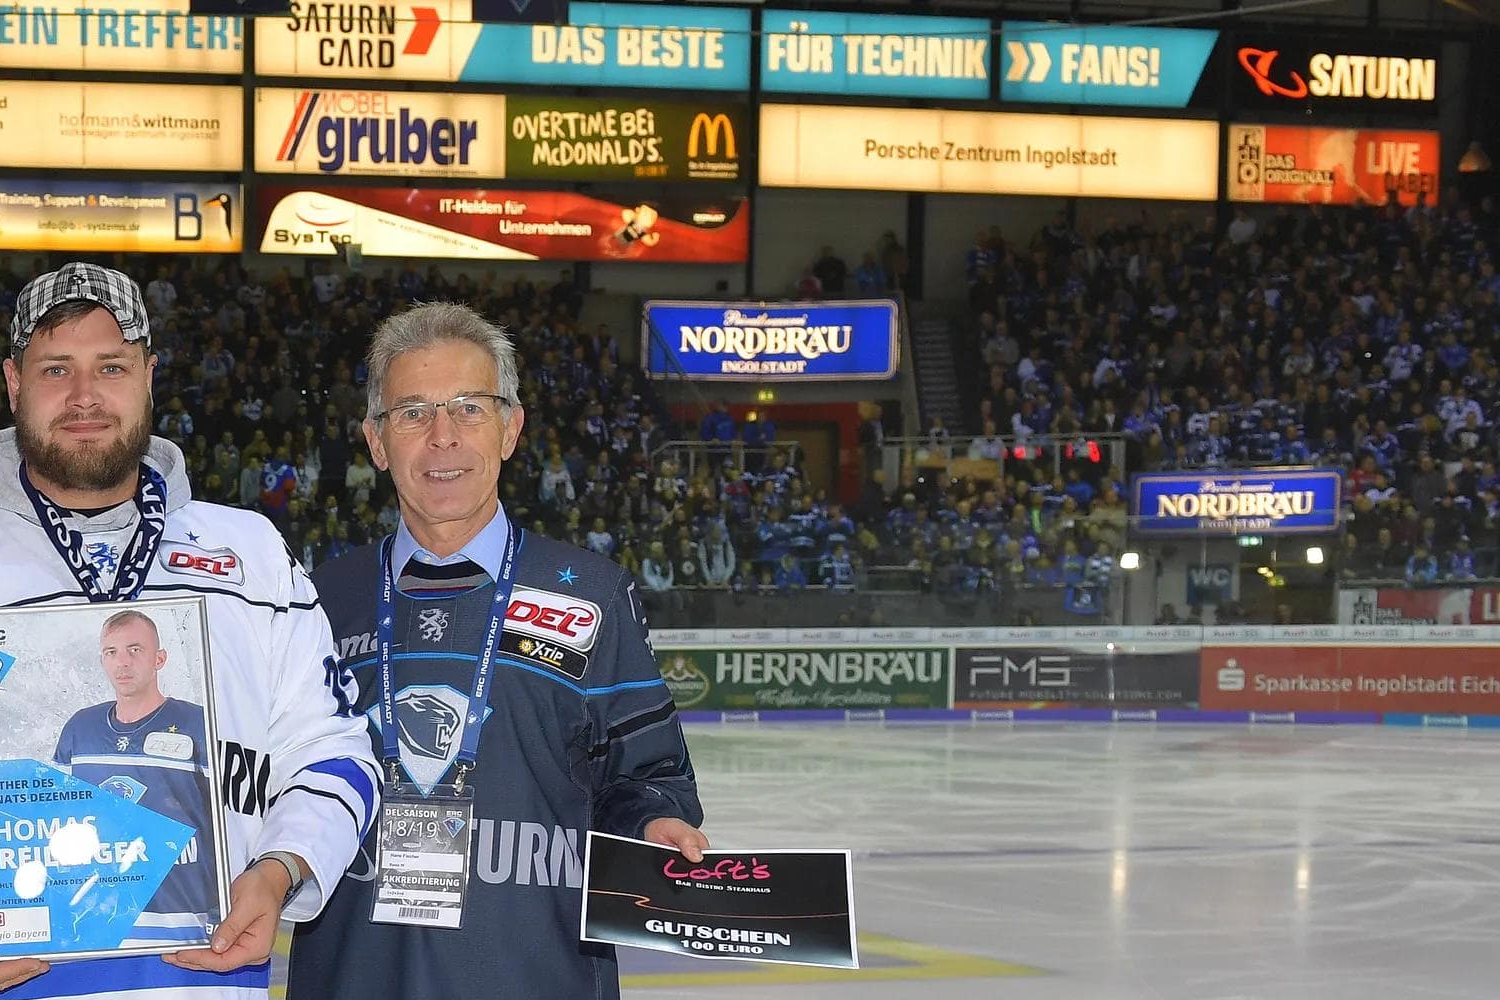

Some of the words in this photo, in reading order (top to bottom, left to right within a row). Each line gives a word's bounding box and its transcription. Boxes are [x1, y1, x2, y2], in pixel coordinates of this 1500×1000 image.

[78, 8, 243, 50] TREFFER!
[287, 2, 396, 35] SATURN
[318, 38, 395, 69] CARD
[531, 24, 604, 65] DAS
[616, 25, 725, 69] BESTE
[768, 22, 832, 73] FÜR
[845, 34, 987, 79] TECHNIK
[1060, 44, 1161, 88] FANS!
[1309, 53, 1436, 100] SATURN
[317, 107, 478, 172] gruber
[863, 139, 941, 162] Porsche
[943, 142, 1022, 164] Zentrum
[1026, 143, 1118, 171] Ingolstadt
[1367, 141, 1421, 176] LIVE
[504, 200, 527, 215] für
[499, 219, 593, 237] Unternehmen
[679, 325, 853, 360] NORDBRÄU
[1156, 490, 1315, 520] NORDBRÄU
[1190, 566, 1231, 588] WC
[504, 599, 595, 638] DEL
[477, 615, 501, 678] INGOLSTADT
[715, 651, 942, 687] HERRNBRÄU
[970, 655, 1071, 687] FMS
[382, 667, 394, 726] INGOLSTADT
[1254, 673, 1353, 696] Sparkasse
[1358, 673, 1456, 697] Ingolstadt
[29, 790, 94, 803] DEZEMBER
[32, 778, 54, 789] DES
[385, 808, 438, 818] DEL-SAISON
[386, 820, 437, 838] 18/19
[382, 874, 461, 887] AKKREDITIERUNG
[13, 929, 48, 941] Bayern
[644, 919, 791, 947] GUTSCHEIN
[680, 939, 714, 952] 100
[719, 943, 764, 955] EURO
